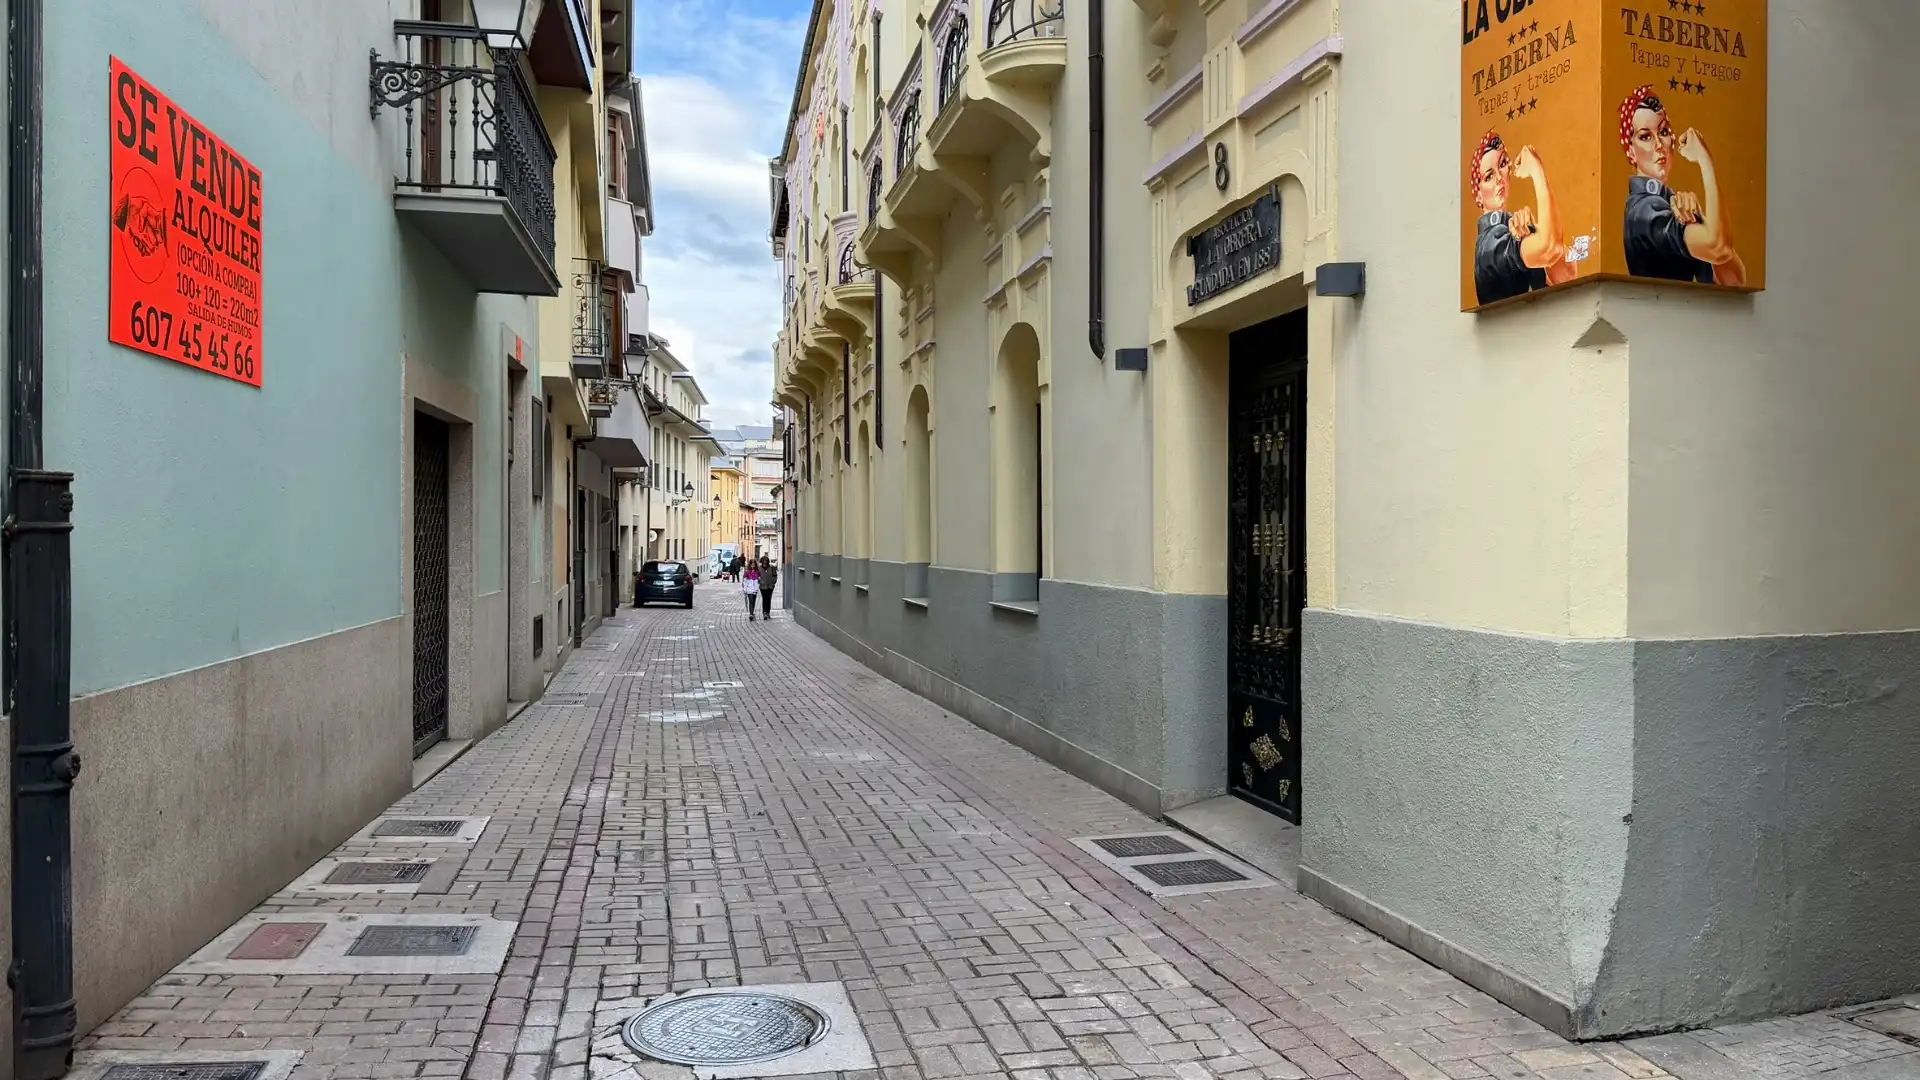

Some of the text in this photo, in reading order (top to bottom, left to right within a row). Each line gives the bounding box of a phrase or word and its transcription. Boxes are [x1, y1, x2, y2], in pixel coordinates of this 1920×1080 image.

[1463, 0, 1489, 45] LA
[1621, 8, 1747, 58] TABERNA
[1472, 20, 1577, 96] TABERNA
[1630, 42, 1741, 81] Tapas y tragos
[1477, 58, 1571, 116] Tapas y tragos
[117, 71, 260, 231] SE VENDE
[1215, 142, 1229, 191] 8
[172, 188, 260, 273] ALQUILER
[1207, 220, 1262, 266] LA OBRERA
[177, 241, 257, 304] (OPCIÓN A COMPRA)
[1193, 264, 1234, 300] FUNDADA
[1237, 256, 1250, 280] EN
[176, 272, 201, 299] 100+
[204, 285, 221, 311] 120
[230, 297, 259, 327] 220m2
[188, 302, 252, 339] SALIDA DE HUMOS
[131, 301, 254, 378] 607 45 45 66
